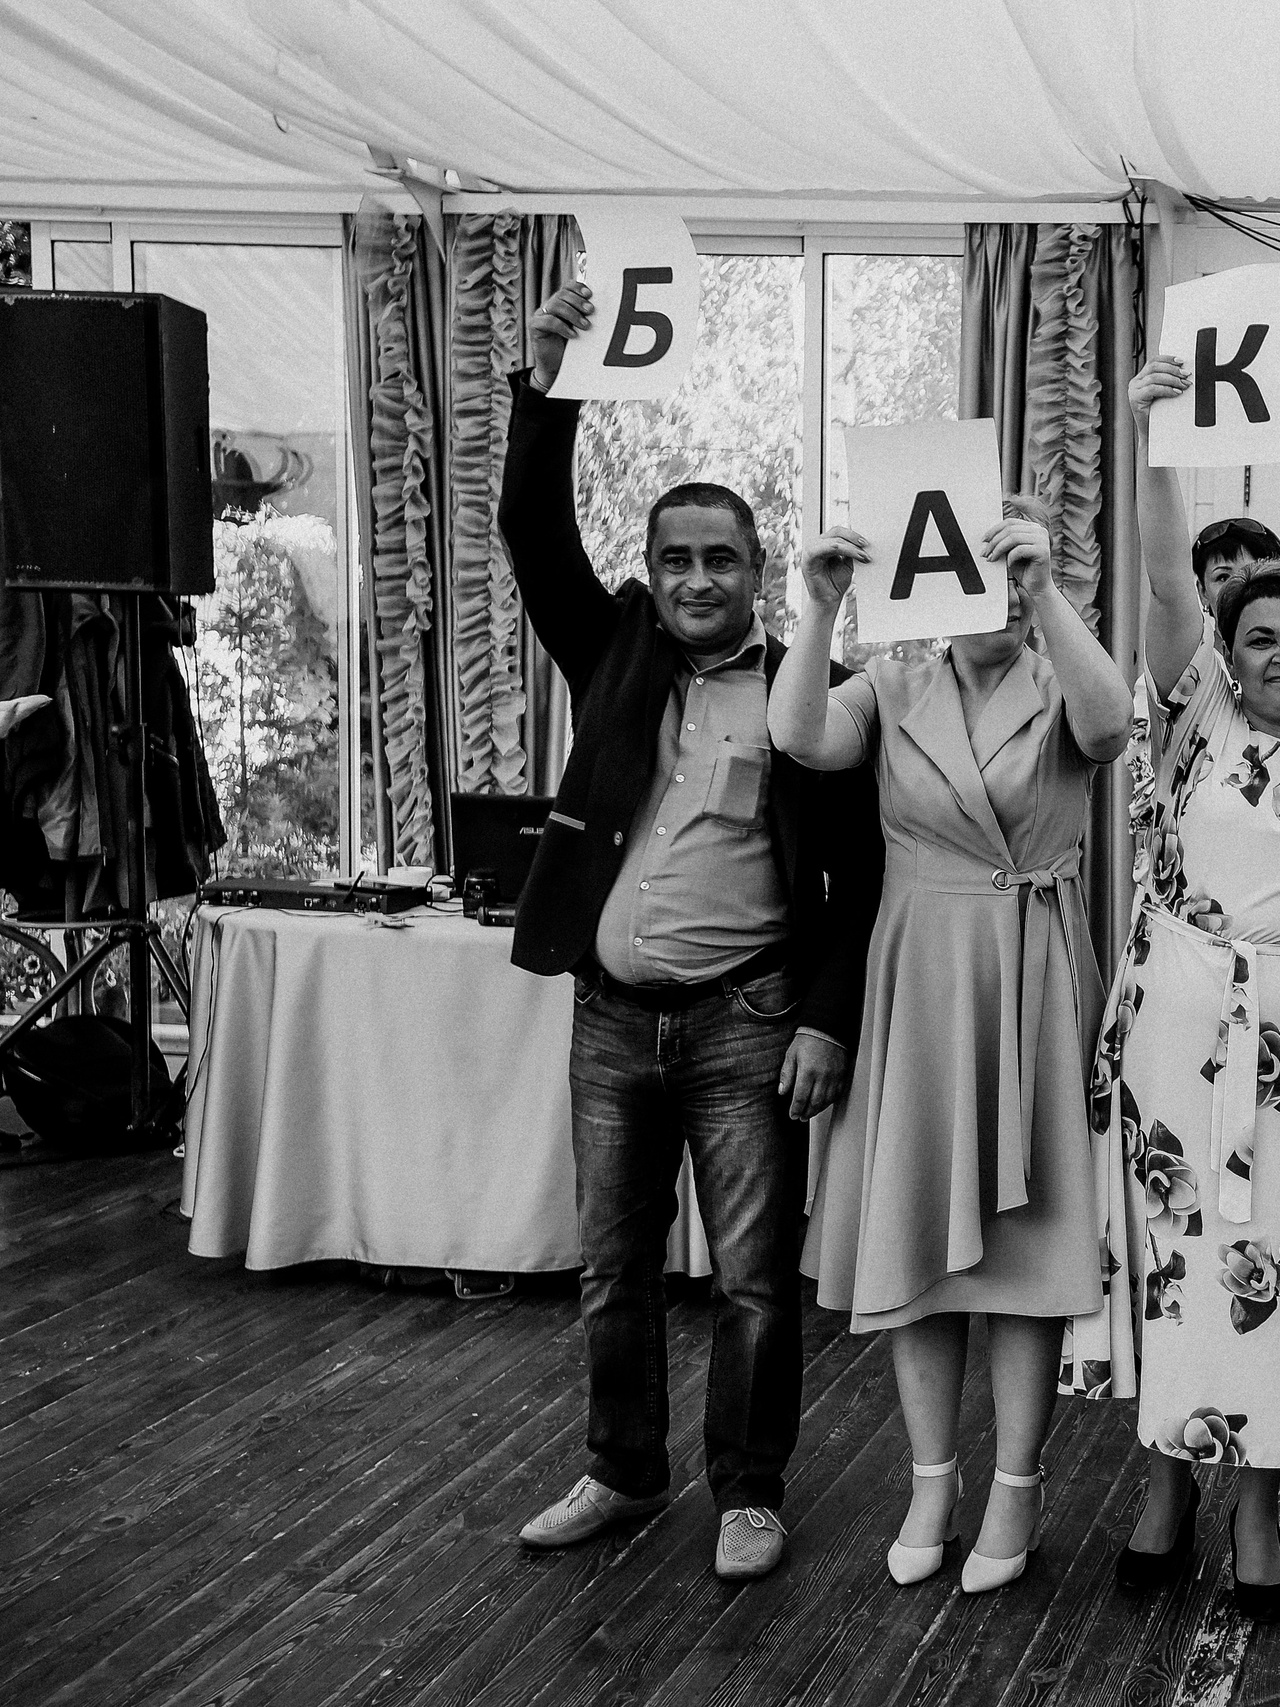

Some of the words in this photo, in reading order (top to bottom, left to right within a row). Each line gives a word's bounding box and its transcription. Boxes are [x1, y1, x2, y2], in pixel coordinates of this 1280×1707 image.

[602, 266, 674, 368] Б
[1194, 324, 1271, 428] К
[889, 490, 986, 601] А
